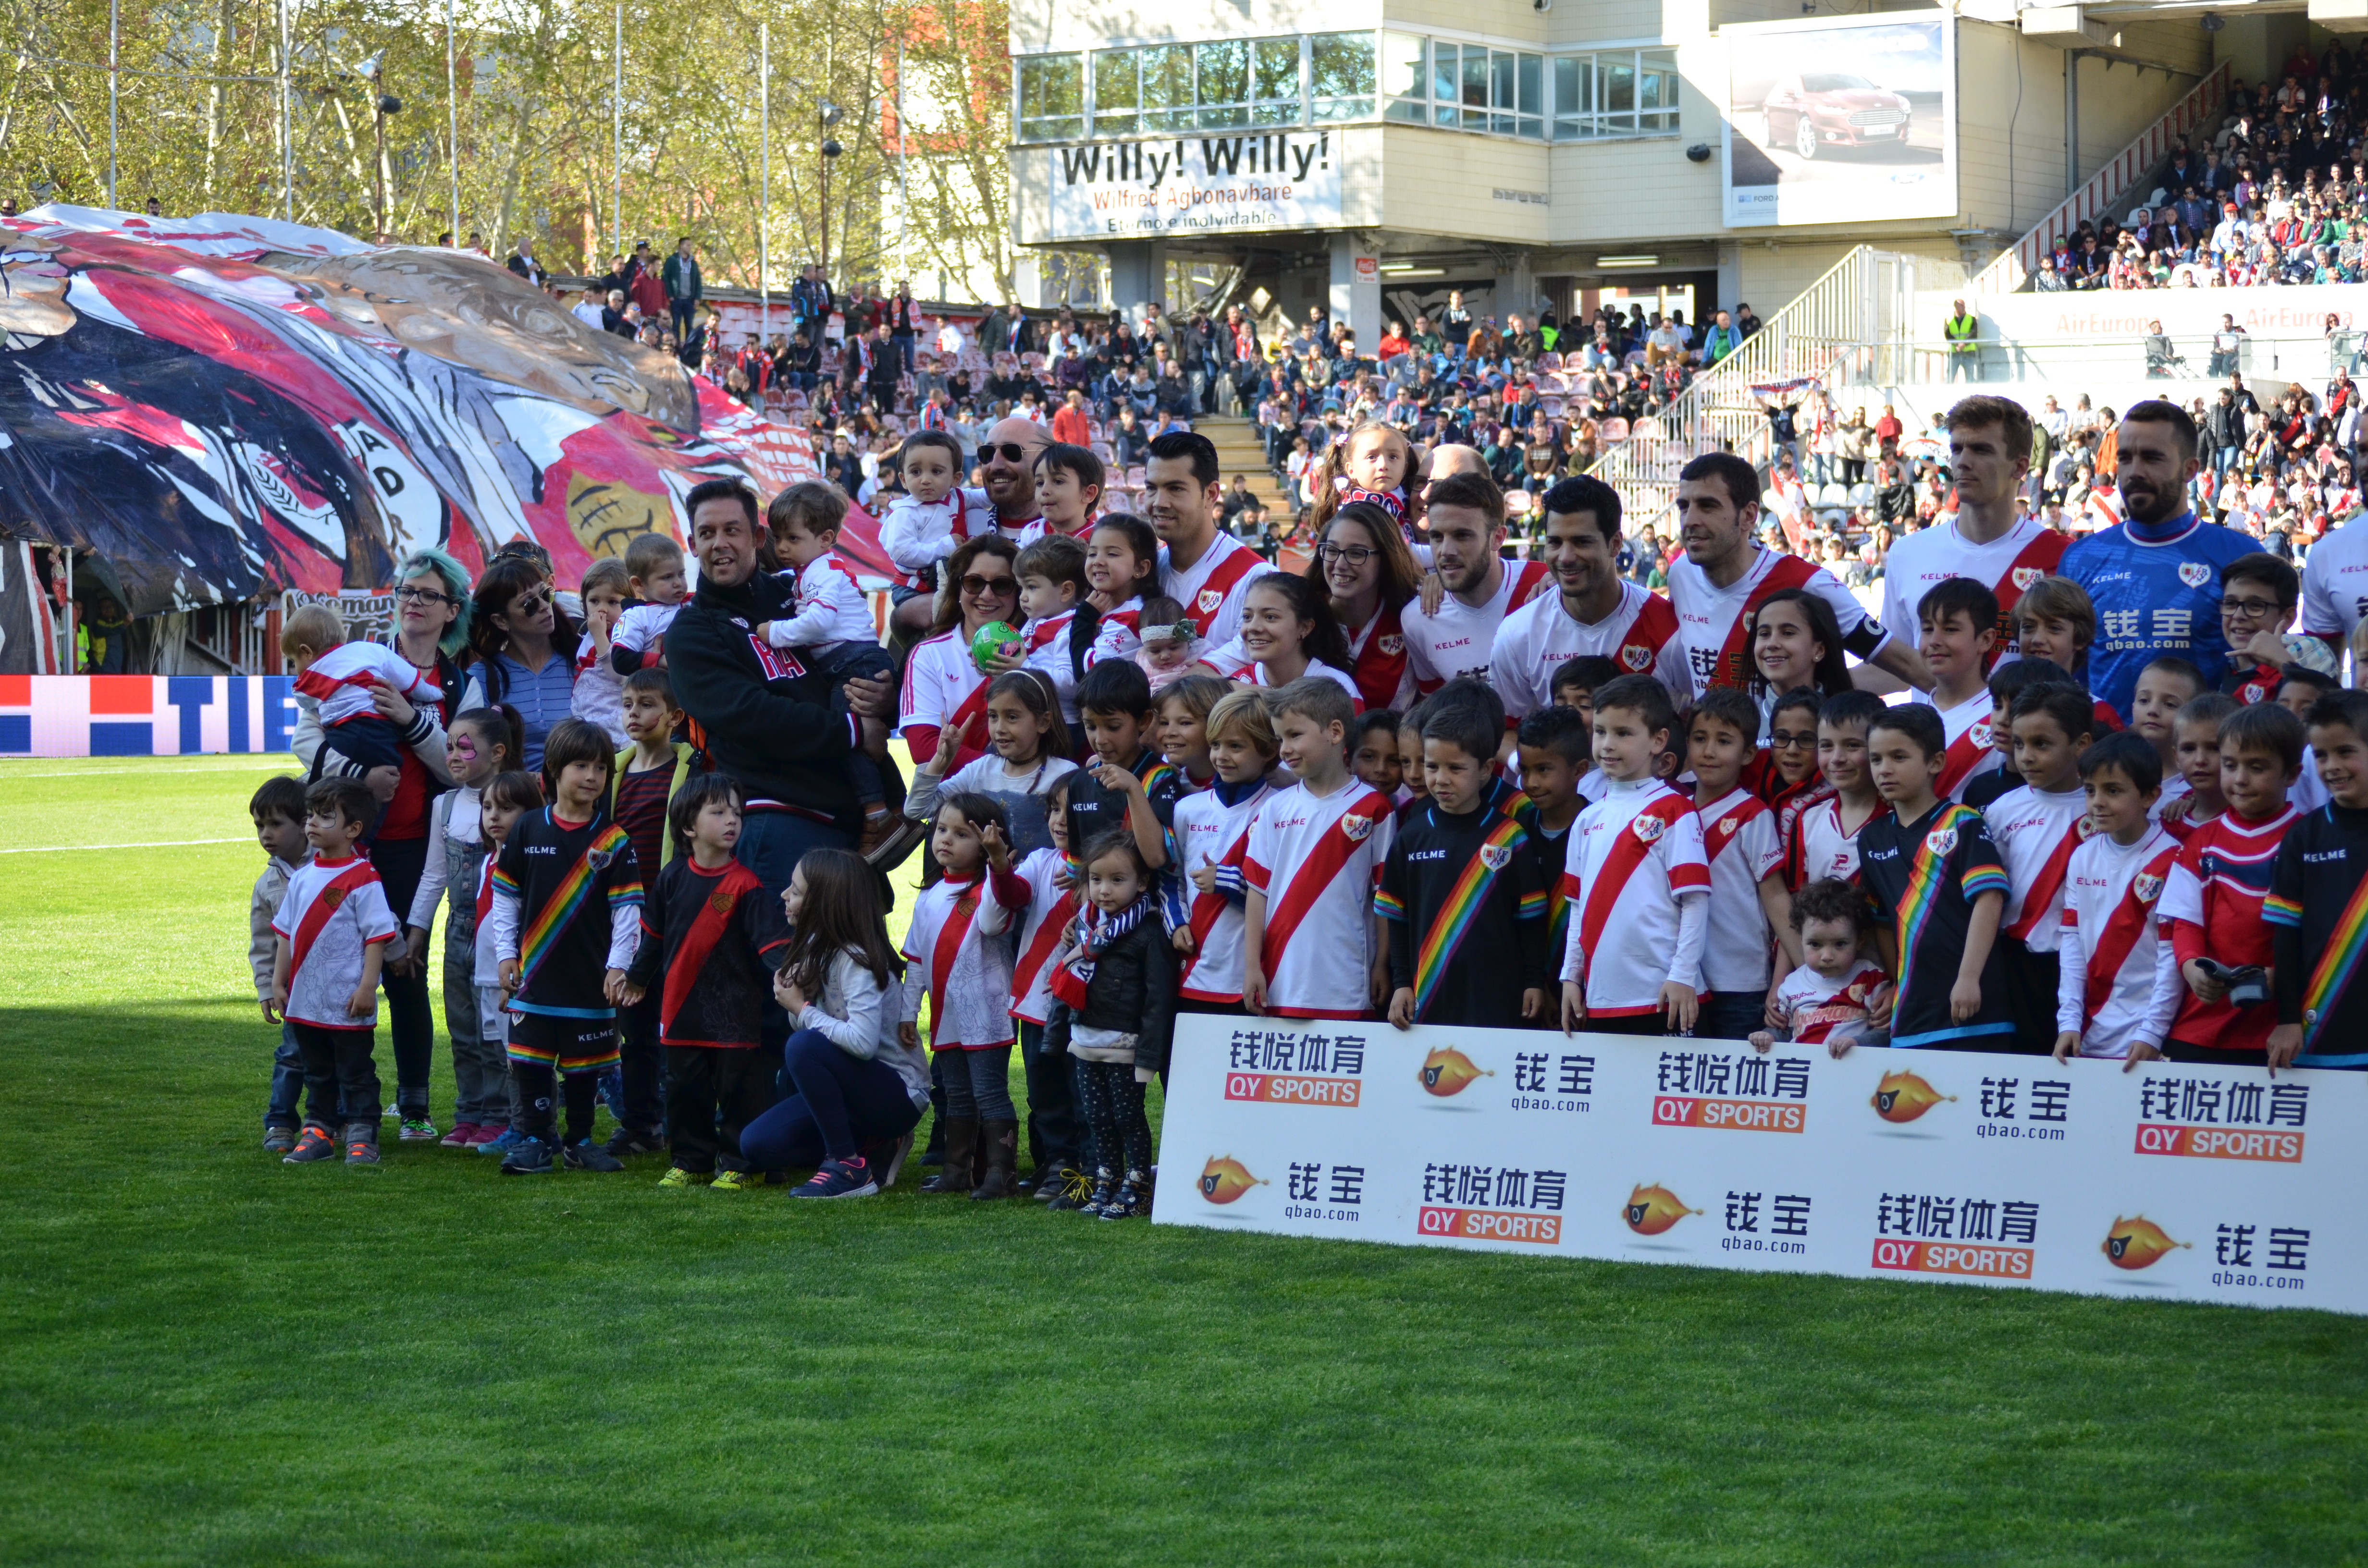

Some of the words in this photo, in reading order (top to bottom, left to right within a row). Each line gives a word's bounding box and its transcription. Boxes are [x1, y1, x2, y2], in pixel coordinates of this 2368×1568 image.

[1061, 141, 1184, 190] Willy!
[1202, 132, 1329, 183] Willy!
[1094, 188, 1158, 209] Wilfred
[1167, 183, 1292, 211] Agbonavbare
[1168, 218, 1177, 228] e
[1183, 210, 1276, 228] inolvidable
[2093, 572, 2131, 583] KELME
[1683, 613, 1709, 624] KELME
[1864, 615, 1884, 635] C
[2104, 608, 2192, 637] 钱宝
[1434, 638, 1470, 650] KELME
[2106, 640, 2190, 651] qbao.com
[1073, 803, 1098, 811] KELME
[524, 846, 556, 855] KELME
[1408, 850, 1445, 861] KELME
[2304, 849, 2345, 862] KELME
[578, 1029, 615, 1042] KELME
[1230, 1030, 1366, 1074] 钱悦体育
[1515, 1052, 1595, 1094] 钱宝
[1657, 1052, 1811, 1099] 钱悦体育
[1230, 1076, 1261, 1097] QY
[1270, 1078, 1356, 1102] SPORTS
[1980, 1077, 2071, 1122] 钱宝
[2141, 1077, 2309, 1126] 钱悦体育
[1512, 1095, 1589, 1112] qbao.com
[1658, 1100, 1693, 1121] QY
[1704, 1102, 1800, 1128] SPORTS
[1977, 1124, 2064, 1140] qbao.com
[2142, 1128, 2179, 1150] QY
[2192, 1131, 2297, 1158] SPORTS
[1288, 1162, 1365, 1204] 钱宝
[1422, 1163, 1566, 1210] 钱悦体育
[1284, 1204, 1359, 1222] qbao.com
[1423, 1211, 1456, 1232] QY
[1466, 1213, 1556, 1239] SPORTS
[1725, 1191, 1811, 1236] 钱宝
[1877, 1193, 2039, 1245] 钱悦体育
[1721, 1236, 1805, 1254] qbao.com
[1878, 1243, 1914, 1265] QY
[1927, 1246, 2027, 1274] SPORTS
[2216, 1224, 2310, 1270] 钱宝
[2212, 1271, 2303, 1290] qbao.com
